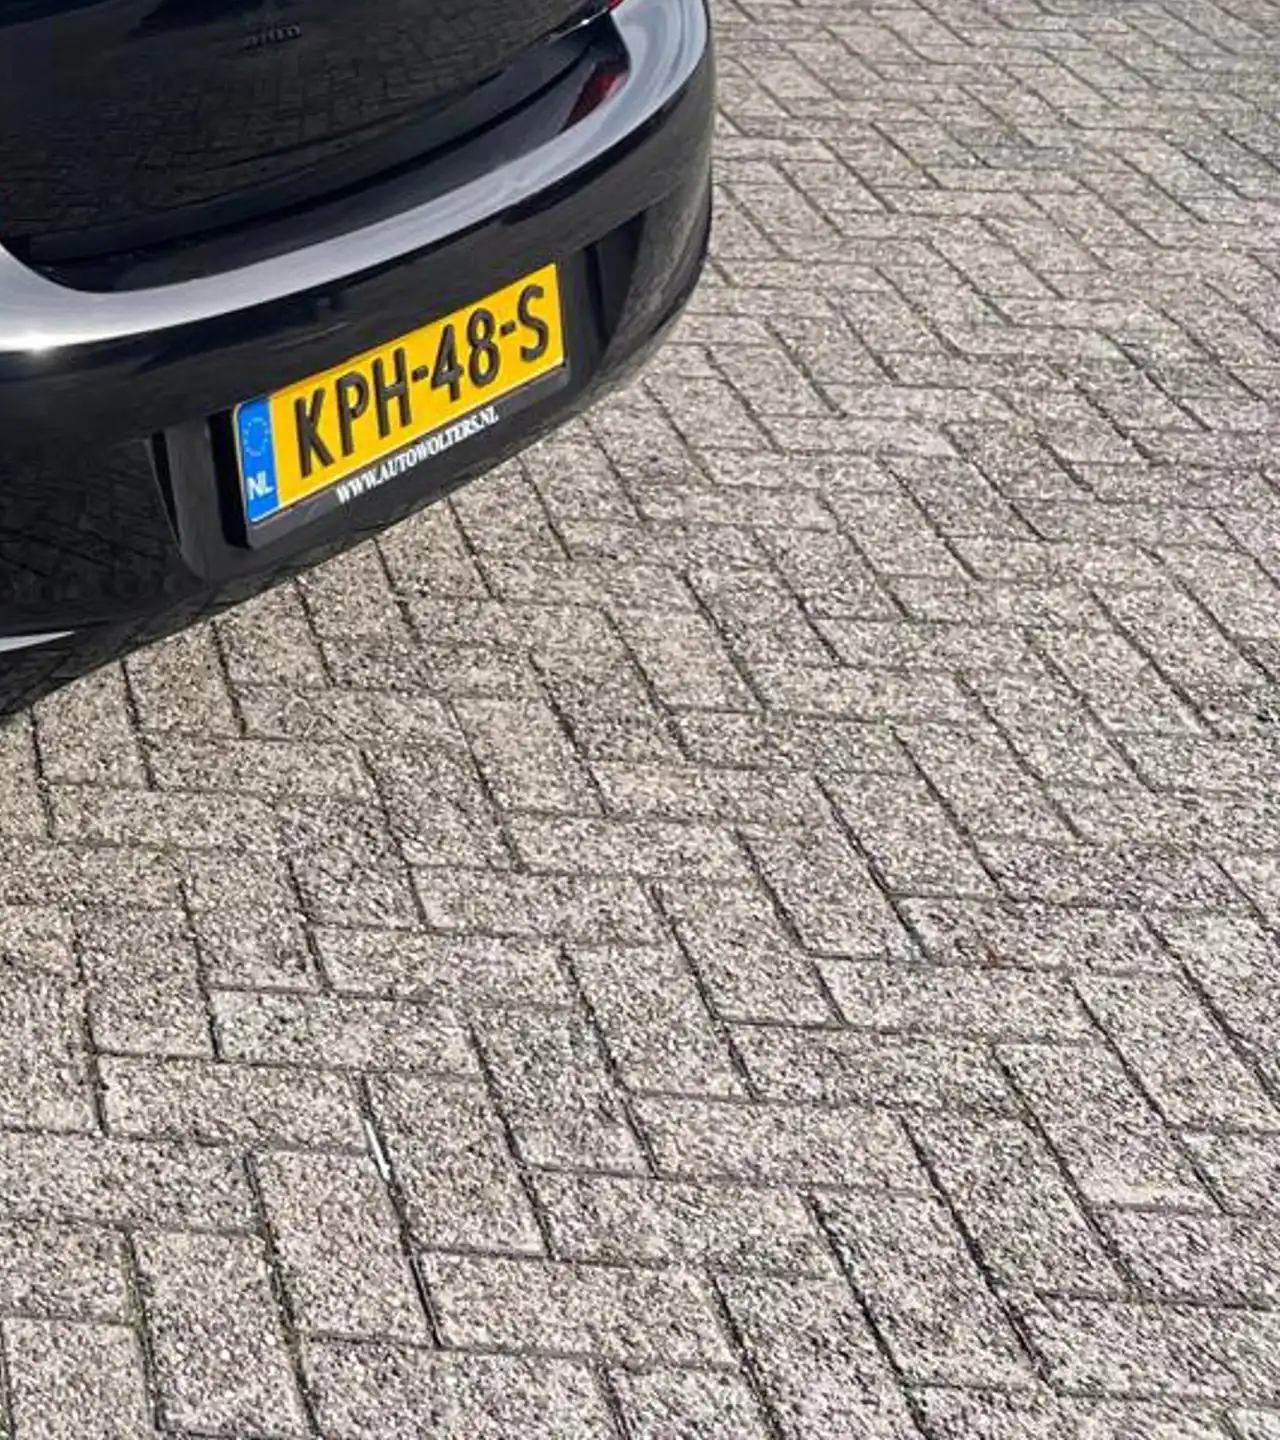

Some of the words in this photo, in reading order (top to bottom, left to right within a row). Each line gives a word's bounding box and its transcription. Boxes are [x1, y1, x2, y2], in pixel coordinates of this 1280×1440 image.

[293, 283, 550, 479] KPH-48-S
[246, 469, 274, 501] NL
[335, 405, 500, 504] WWW.AUTOWOLTERS.NL
